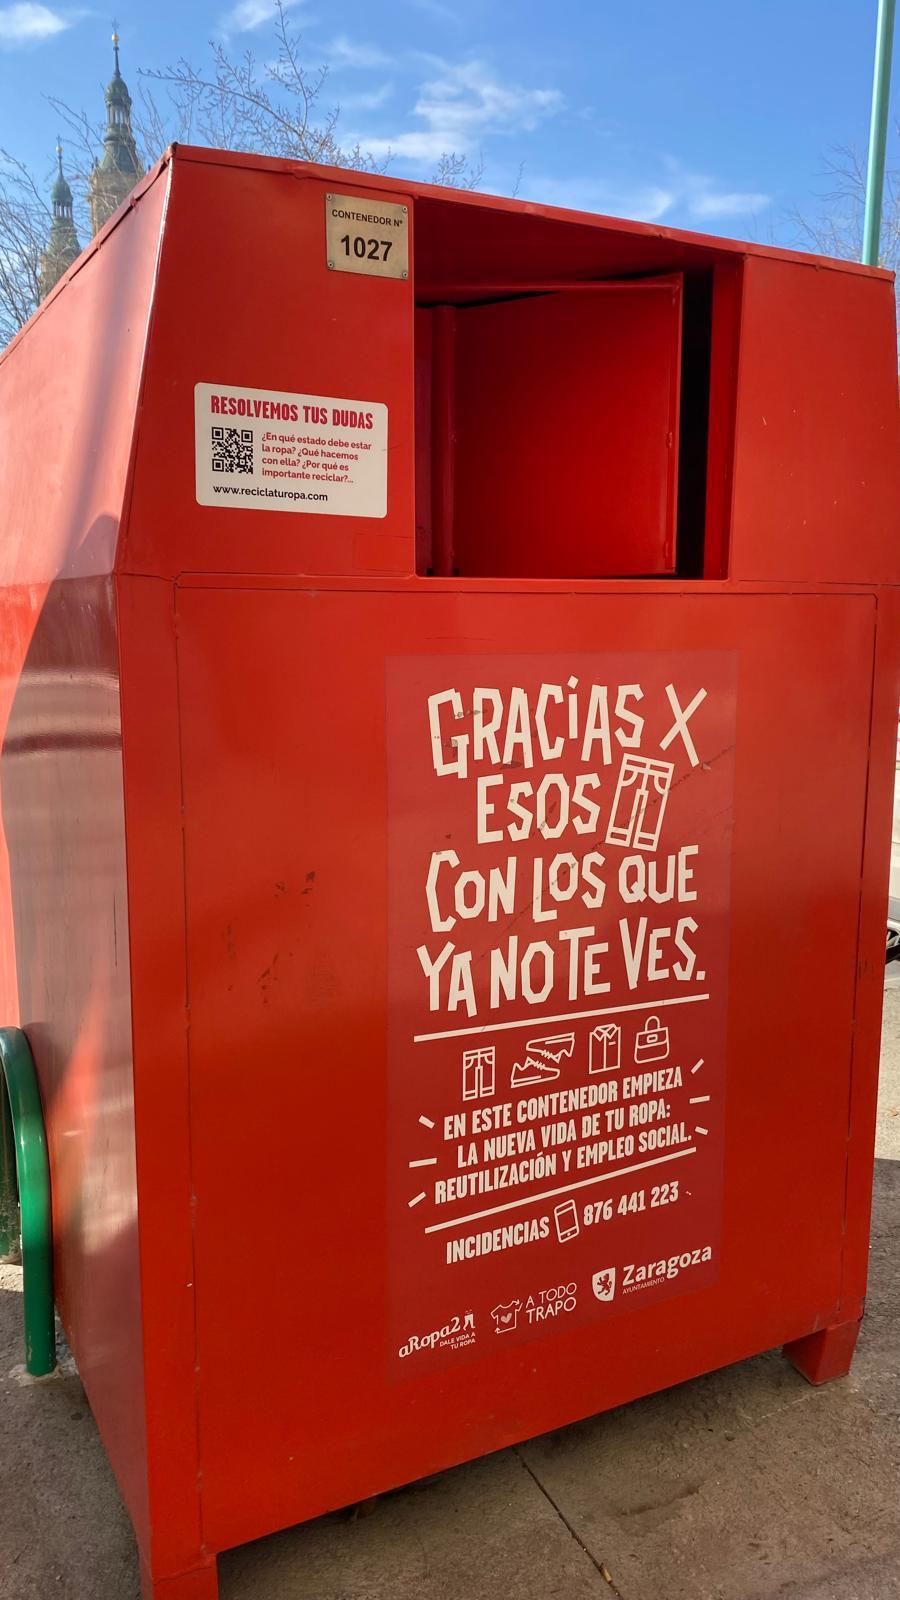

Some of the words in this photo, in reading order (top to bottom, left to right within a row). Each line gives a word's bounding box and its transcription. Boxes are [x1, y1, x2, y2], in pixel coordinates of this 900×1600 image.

[332, 209, 391, 225] CONTENEDOR
[341, 235, 392, 261] 1027
[211, 395, 298, 421] RESOLVEMOS
[303, 405, 328, 424] TUS
[332, 409, 373, 429] DUDAS
[262, 432, 276, 442] ¿En
[279, 433, 295, 443] qué
[297, 436, 326, 446] estado
[328, 438, 349, 448] debe
[351, 441, 372, 450] estar
[262, 444, 270, 452] la
[272, 446, 296, 455] ropa?
[298, 448, 319, 458] ¿Qué
[321, 450, 358, 460] hacemos
[262, 468, 311, 480] importante
[312, 473, 354, 483] reciclar?...
[280, 458, 300, 467] ella?
[302, 460, 320, 470] ¿Por
[322, 462, 338, 471] qué
[213, 486, 328, 501] www.reciclaturopa.com
[659, 683, 708, 768] X
[478, 773, 600, 844] ESOS
[532, 851, 606, 923] LOS
[618, 844, 699, 904] QUE
[416, 941, 478, 1018] YA
[490, 936, 554, 1008] NO
[559, 926, 611, 1000] TE
[619, 916, 706, 990] VES.
[444, 1113, 466, 1140] EN
[472, 1103, 512, 1134] ESTE
[517, 1080, 618, 1123] CONTENEDOR
[622, 1066, 682, 1099] EMPIEZA
[458, 1142, 478, 1168] LA
[483, 1128, 536, 1162] NUEVA
[541, 1119, 576, 1148] VIDA
[582, 1113, 600, 1139] DE
[605, 1108, 624, 1133] TU
[629, 1098, 671, 1127] ROPA:
[434, 1152, 556, 1204] REUTILIZACIÓN
[562, 1150, 573, 1172] Y
[576, 1134, 634, 1169] EMPLEO
[638, 1122, 692, 1153] SOCIAL.
[446, 1216, 550, 1264] INCIDENCIAS
[583, 1199, 613, 1226] 876
[617, 1190, 646, 1216] 441
[651, 1181, 679, 1208] 223
[622, 1246, 712, 1286] Zaragoza
[525, 1296, 535, 1309] A
[538, 1282, 577, 1304] TODO
[622, 1277, 665, 1295] AYUNTAMIENTO
[526, 1296, 577, 1324] TRAPO
[439, 1339, 454, 1347] DALE
[456, 1334, 470, 1343] VIDA
[459, 1338, 476, 1348] ROPA
